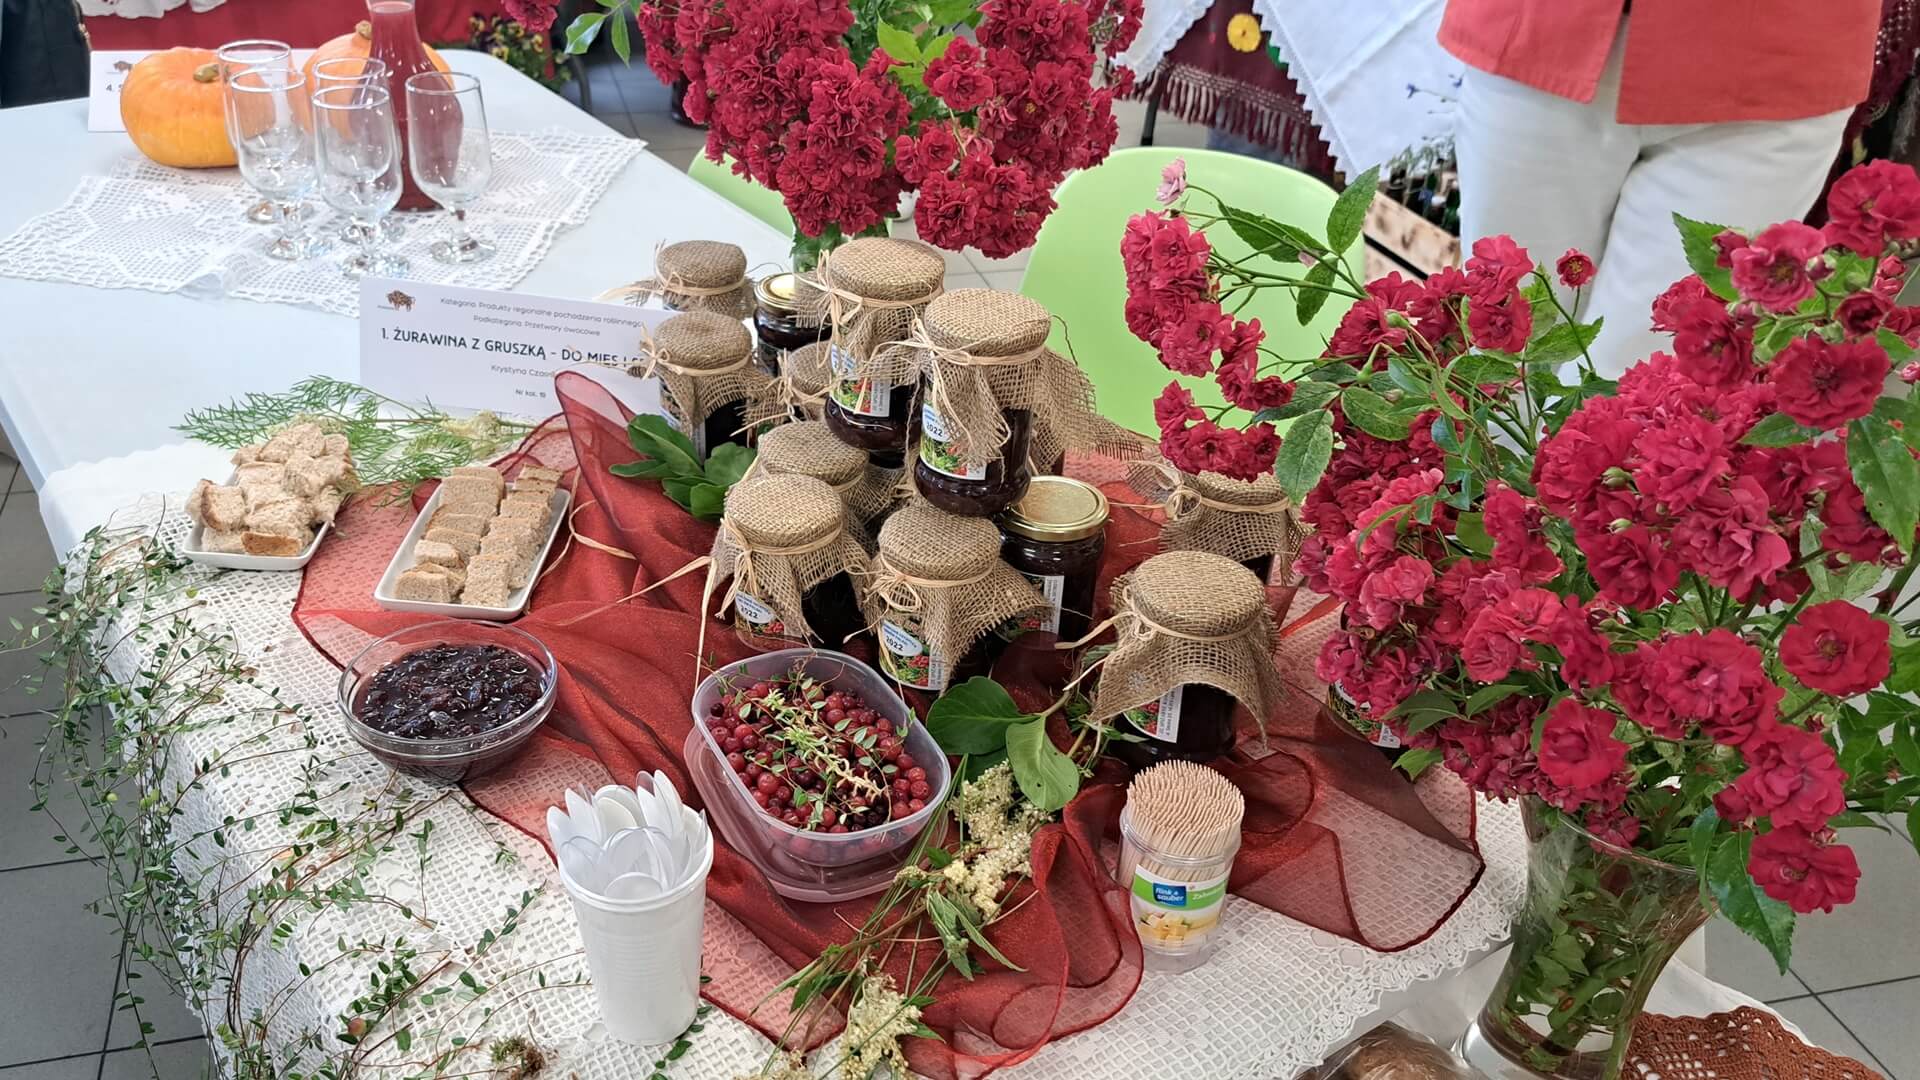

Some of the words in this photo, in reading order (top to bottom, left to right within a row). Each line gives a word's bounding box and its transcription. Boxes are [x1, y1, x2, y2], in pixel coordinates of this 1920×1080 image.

[382, 327, 389, 340] 1.
[393, 325, 467, 349] ŻURAWINA
[472, 338, 480, 350] Z
[484, 339, 546, 360] GRUSZKĄ
[562, 349, 582, 361] DO
[491, 364, 526, 375] Krystyna
[1157, 894, 1184, 902] sauber
